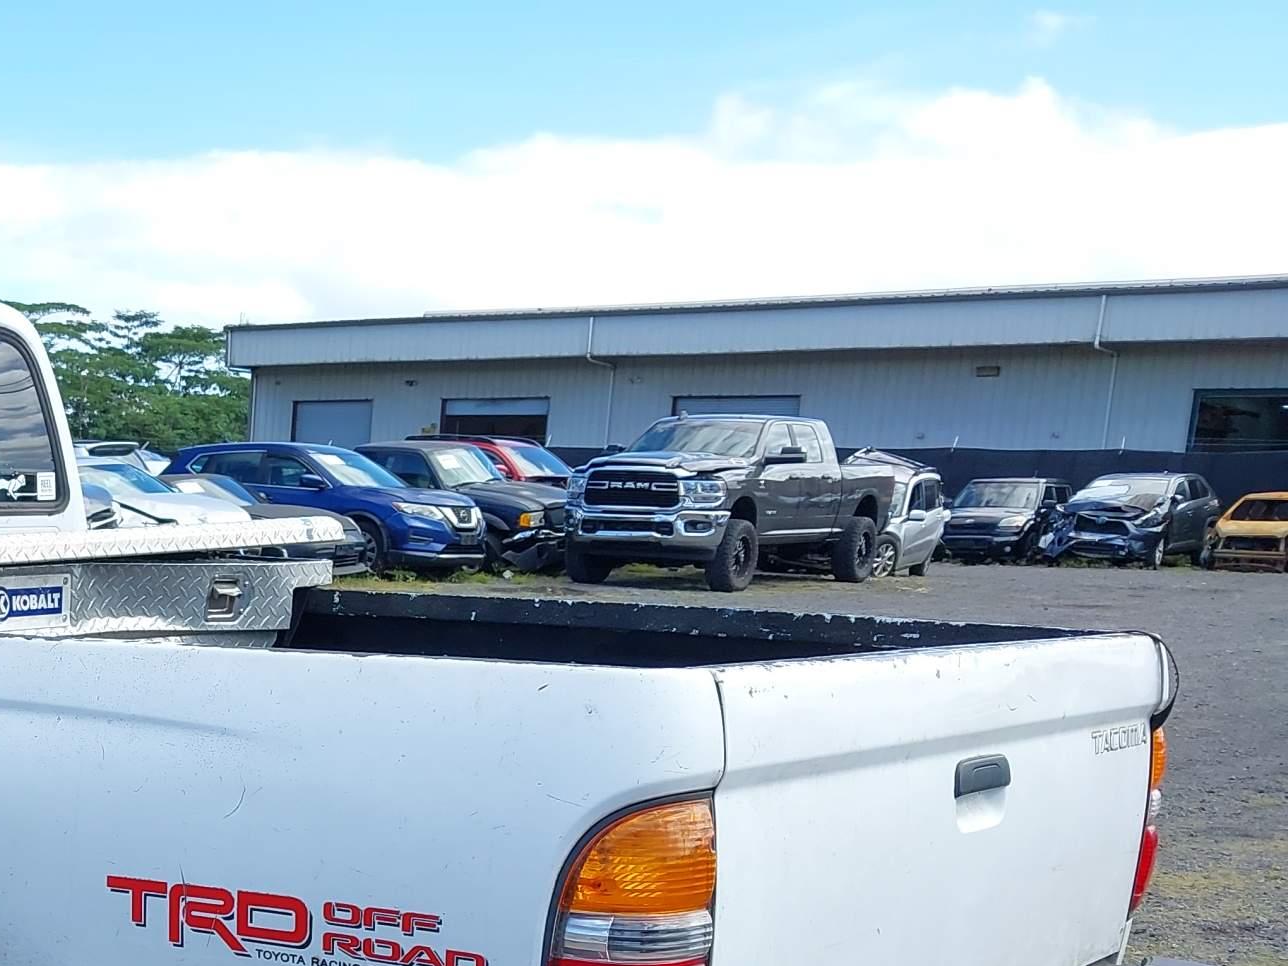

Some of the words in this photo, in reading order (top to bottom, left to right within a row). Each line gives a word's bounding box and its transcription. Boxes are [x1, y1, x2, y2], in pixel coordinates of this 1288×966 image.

[609, 481, 650, 490] RAM
[12, 592, 61, 612] KOBALT
[1091, 722, 1147, 755] TACOMA
[106, 874, 314, 959] TRD
[323, 901, 442, 934] OFF
[254, 948, 306, 966] TOYOTA
